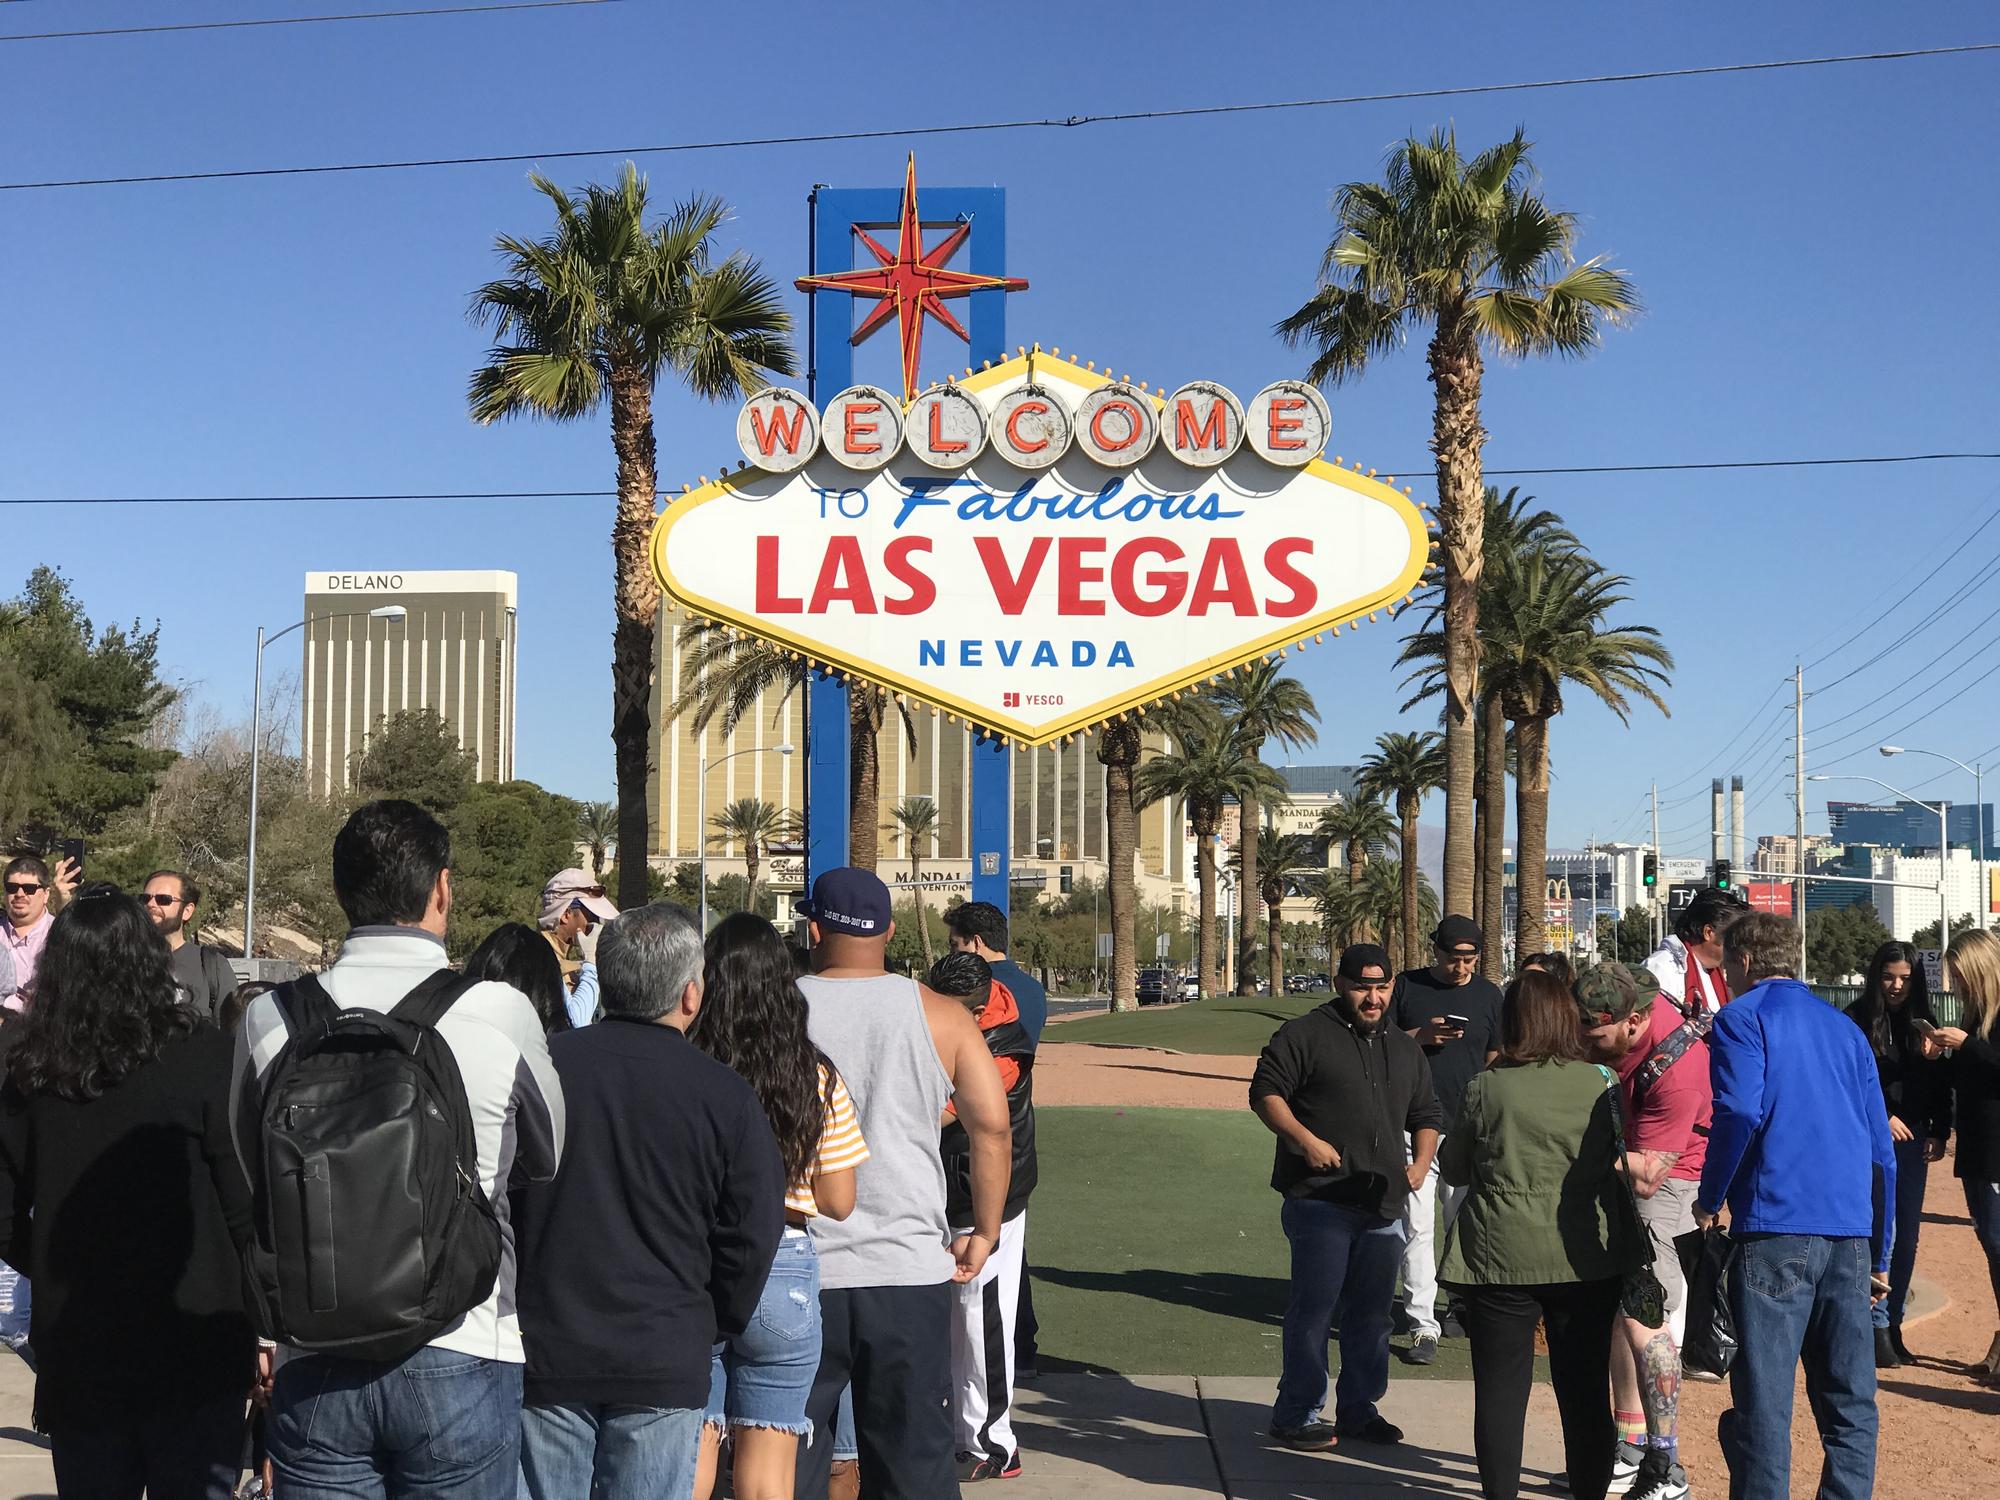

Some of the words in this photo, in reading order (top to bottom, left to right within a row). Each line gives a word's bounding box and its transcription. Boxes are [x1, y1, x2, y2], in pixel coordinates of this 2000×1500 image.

[750, 399, 1308, 456] WELCOME
[811, 488, 869, 519] TO
[893, 476, 1245, 530] Fabulous
[328, 574, 403, 590] DELANO
[755, 535, 937, 616] LAS
[972, 536, 1319, 618] VEGAS
[919, 639, 1135, 668] NEVADA
[1026, 694, 1064, 706] YESCO
[901, 884, 966, 892] COVENTION
